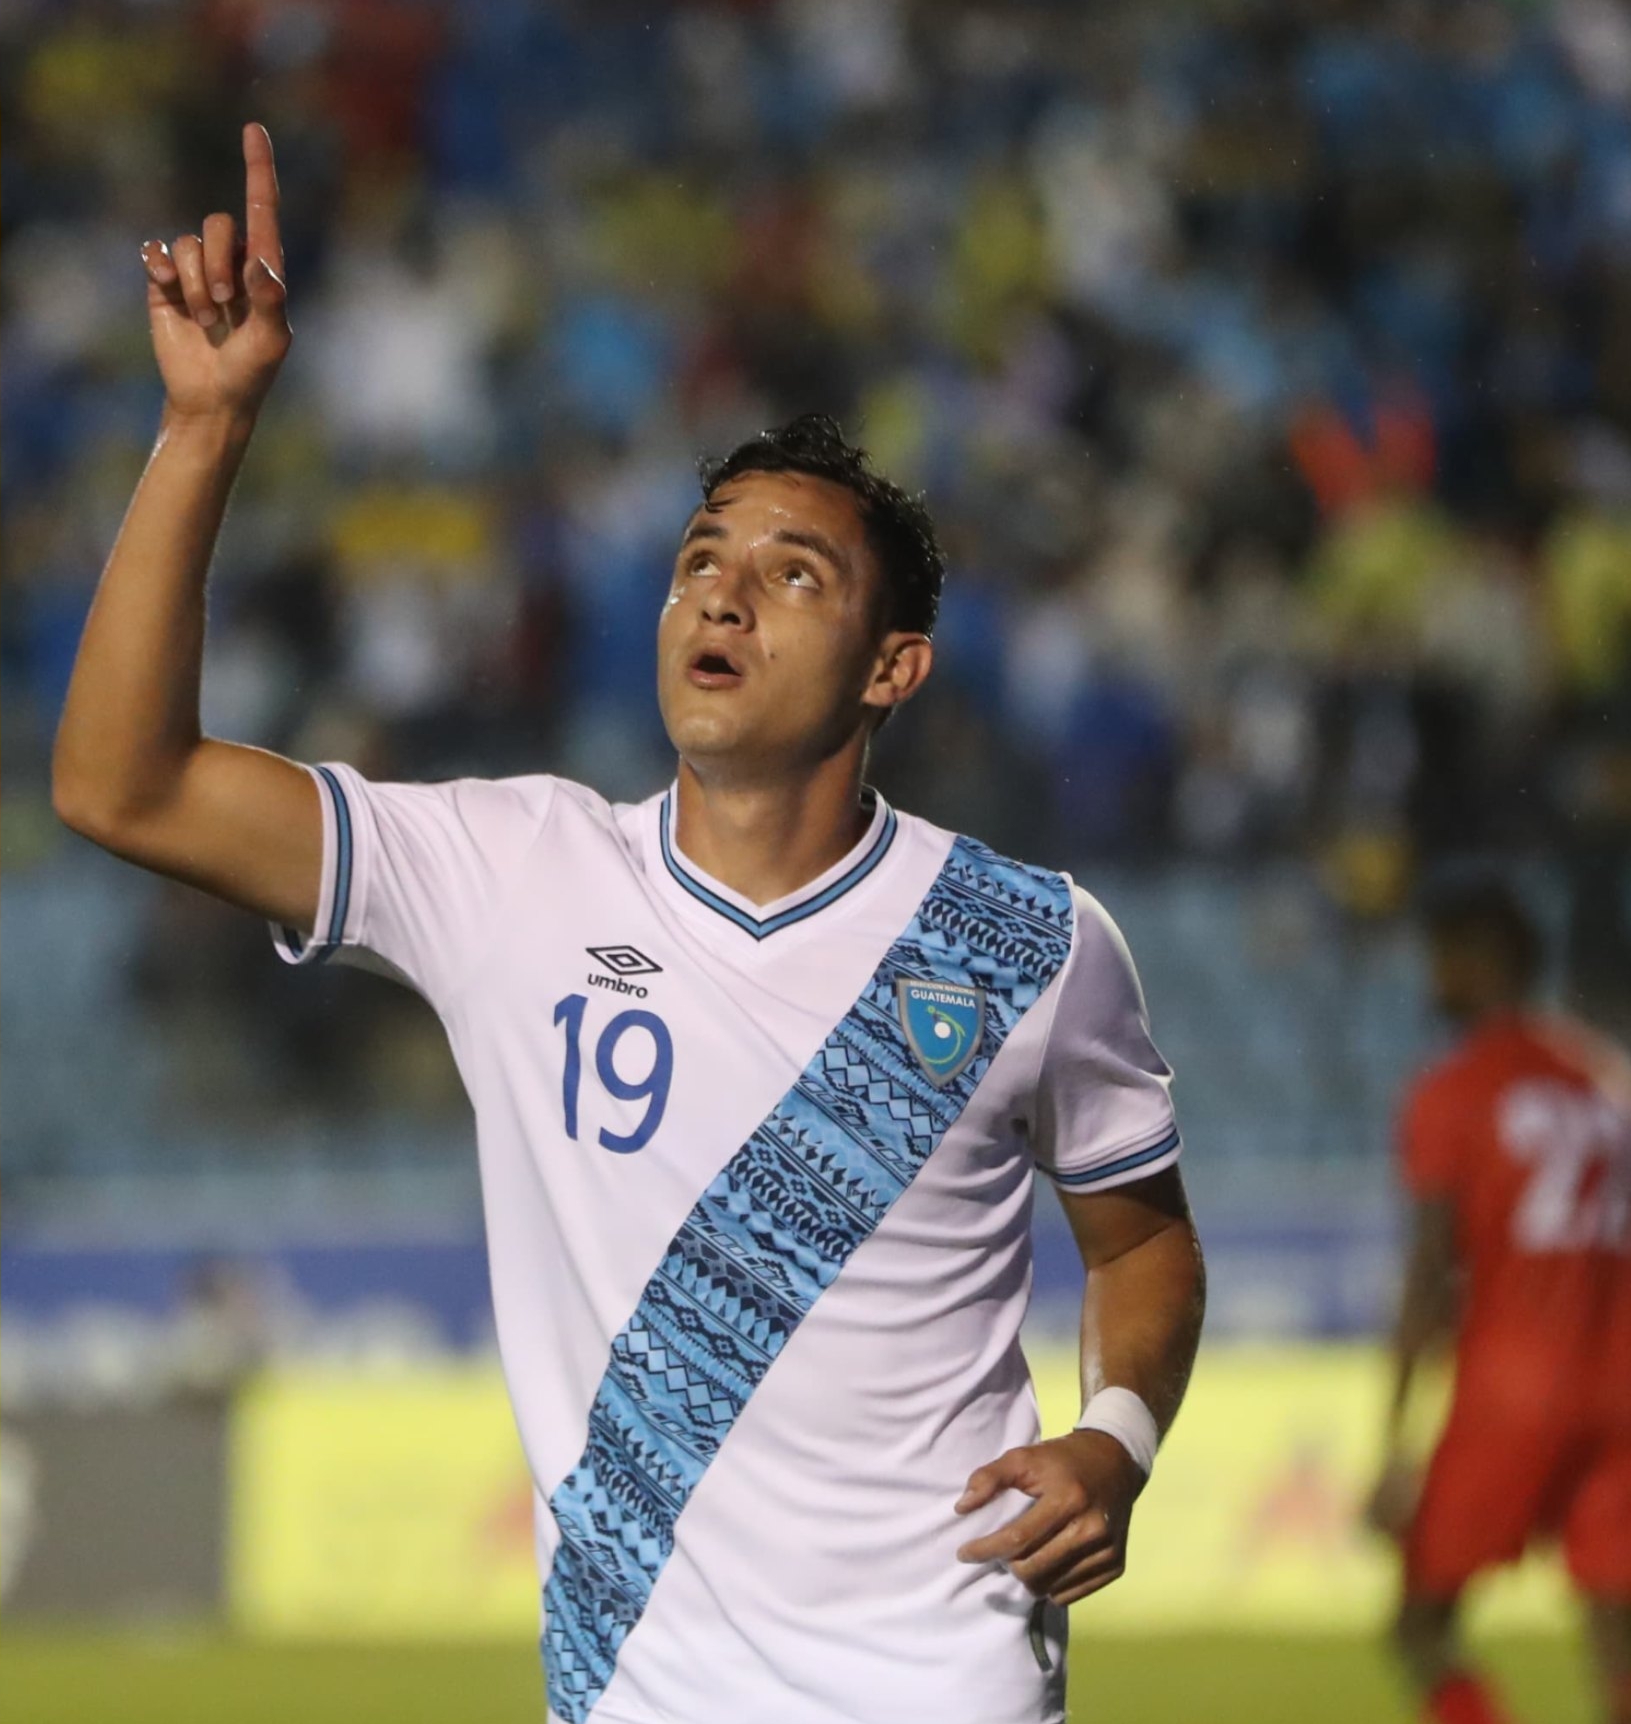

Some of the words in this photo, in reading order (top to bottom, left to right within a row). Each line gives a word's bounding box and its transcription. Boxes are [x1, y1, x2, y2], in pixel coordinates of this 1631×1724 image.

[586, 972, 649, 999] umbro
[910, 989, 977, 1010] GUATEMALA
[553, 993, 674, 1155] 19
